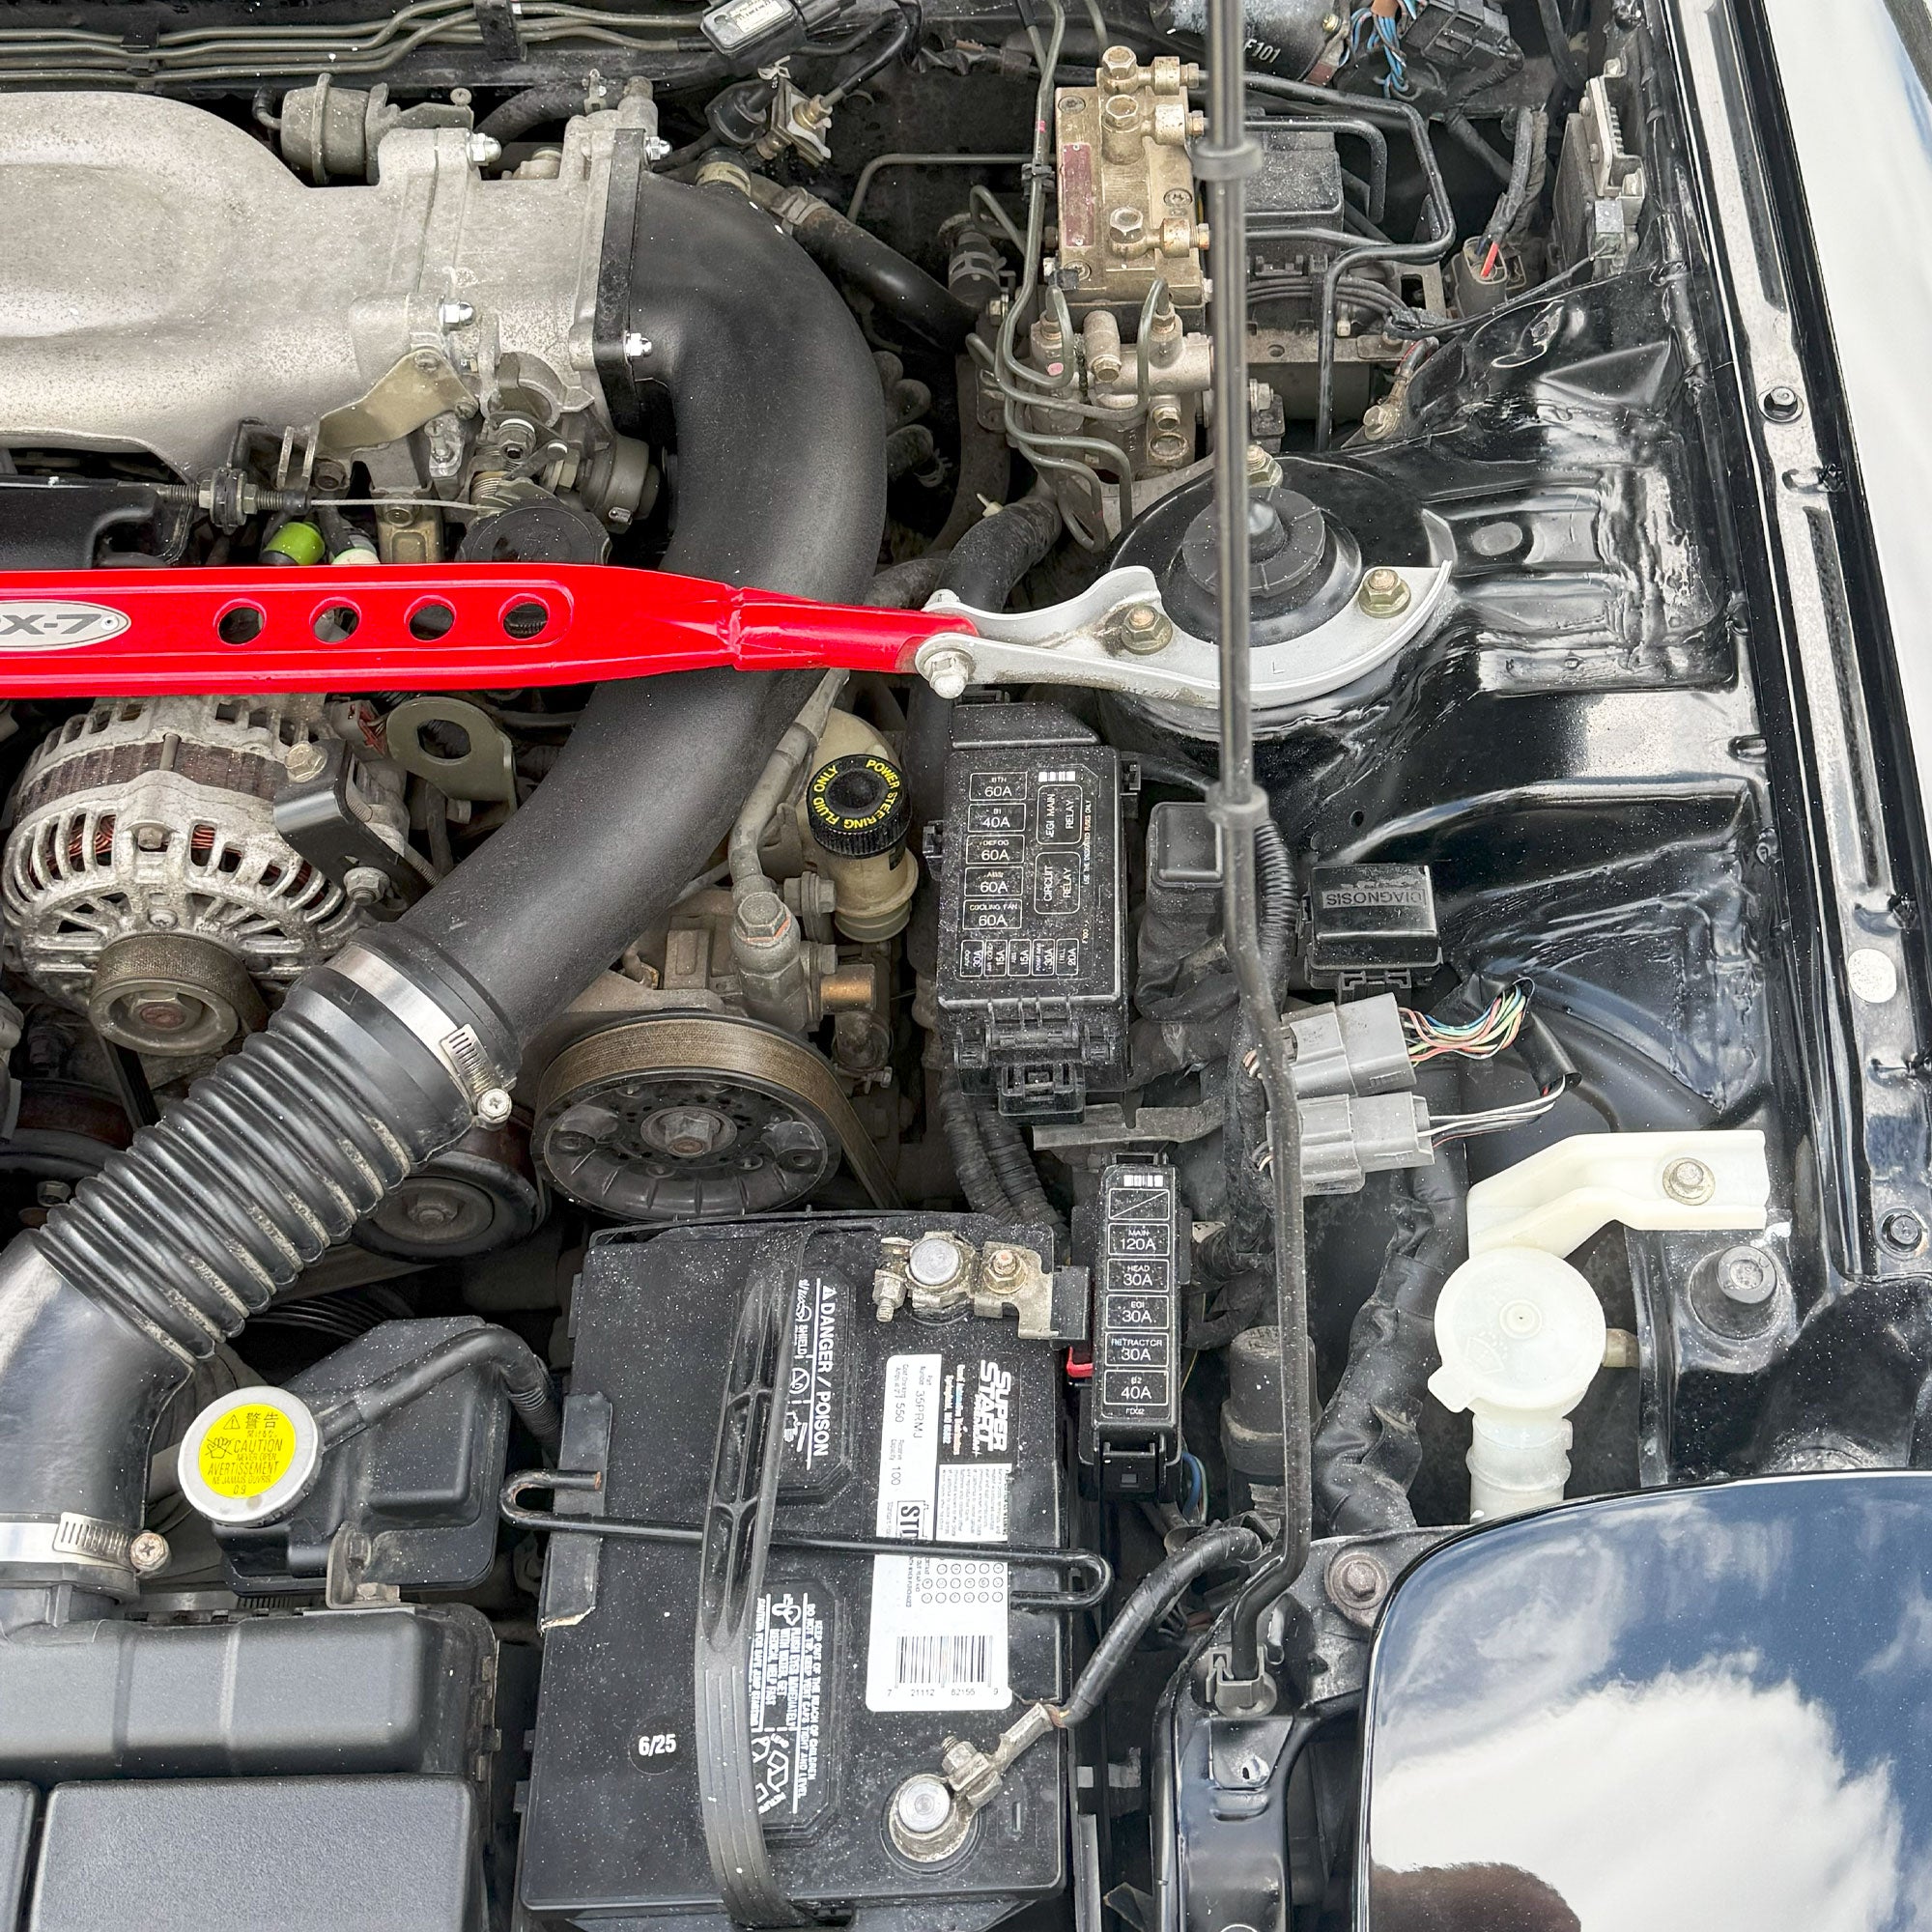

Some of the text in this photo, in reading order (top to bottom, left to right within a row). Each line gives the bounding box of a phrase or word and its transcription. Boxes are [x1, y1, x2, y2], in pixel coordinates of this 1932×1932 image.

[0, 613, 101, 635] X-7
[813, 759, 899, 829] POWER STEERING FLUID ONLY
[984, 786, 1011, 797] 60A
[982, 816, 1010, 828] 40A
[981, 849, 1009, 861] 60A
[980, 882, 1008, 893] 60A
[1326, 891, 1423, 905] DIAGNOSIS
[979, 915, 1008, 926] 60A
[973, 951, 981, 967] 30A
[995, 950, 1005, 965] 15A
[1044, 949, 1053, 966] 30A
[1067, 949, 1076, 965] 20A
[1121, 1237, 1156, 1250] 120A
[1123, 1274, 1152, 1286] 30A
[1122, 1310, 1152, 1322] 30A
[798, 1324, 808, 1354] SHIELD
[1122, 1349, 1151, 1360] 30A
[813, 1302, 836, 1456] DANGER / POISON
[1122, 1386, 1151, 1399] 40A
[895, 1403, 905, 1422] 550
[978, 1359, 999, 1452] START
[994, 1372, 1011, 1451] SUPER
[245, 1412, 278, 1429] 警告
[913, 1391, 924, 1437] 35PRMJ
[234, 1439, 282, 1453] CAUTION
[208, 1462, 279, 1475] AVERTISSEMENT
[892, 1466, 900, 1485] 100
[222, 1475, 246, 1484] JAMAIS
[808, 1604, 815, 1616] DO
[806, 1618, 814, 1634] NOT
[780, 1629, 789, 1648] WITH
[813, 1643, 822, 1660] OUT
[765, 1629, 779, 1705] MEDICAL HELP FAST
[812, 1662, 821, 1674] OF
[786, 1628, 801, 1726] FLUSH EYES IMMEDIATELY
[778, 1680, 787, 1696] GET
[803, 1678, 811, 1698] VENT
[802, 1701, 810, 1723] CAPS
[801, 1725, 810, 1750] TIGHT
[810, 1724, 818, 1736] OF
[638, 1734, 676, 1757] 6/25
[808, 1739, 817, 1779] CHILDREN
